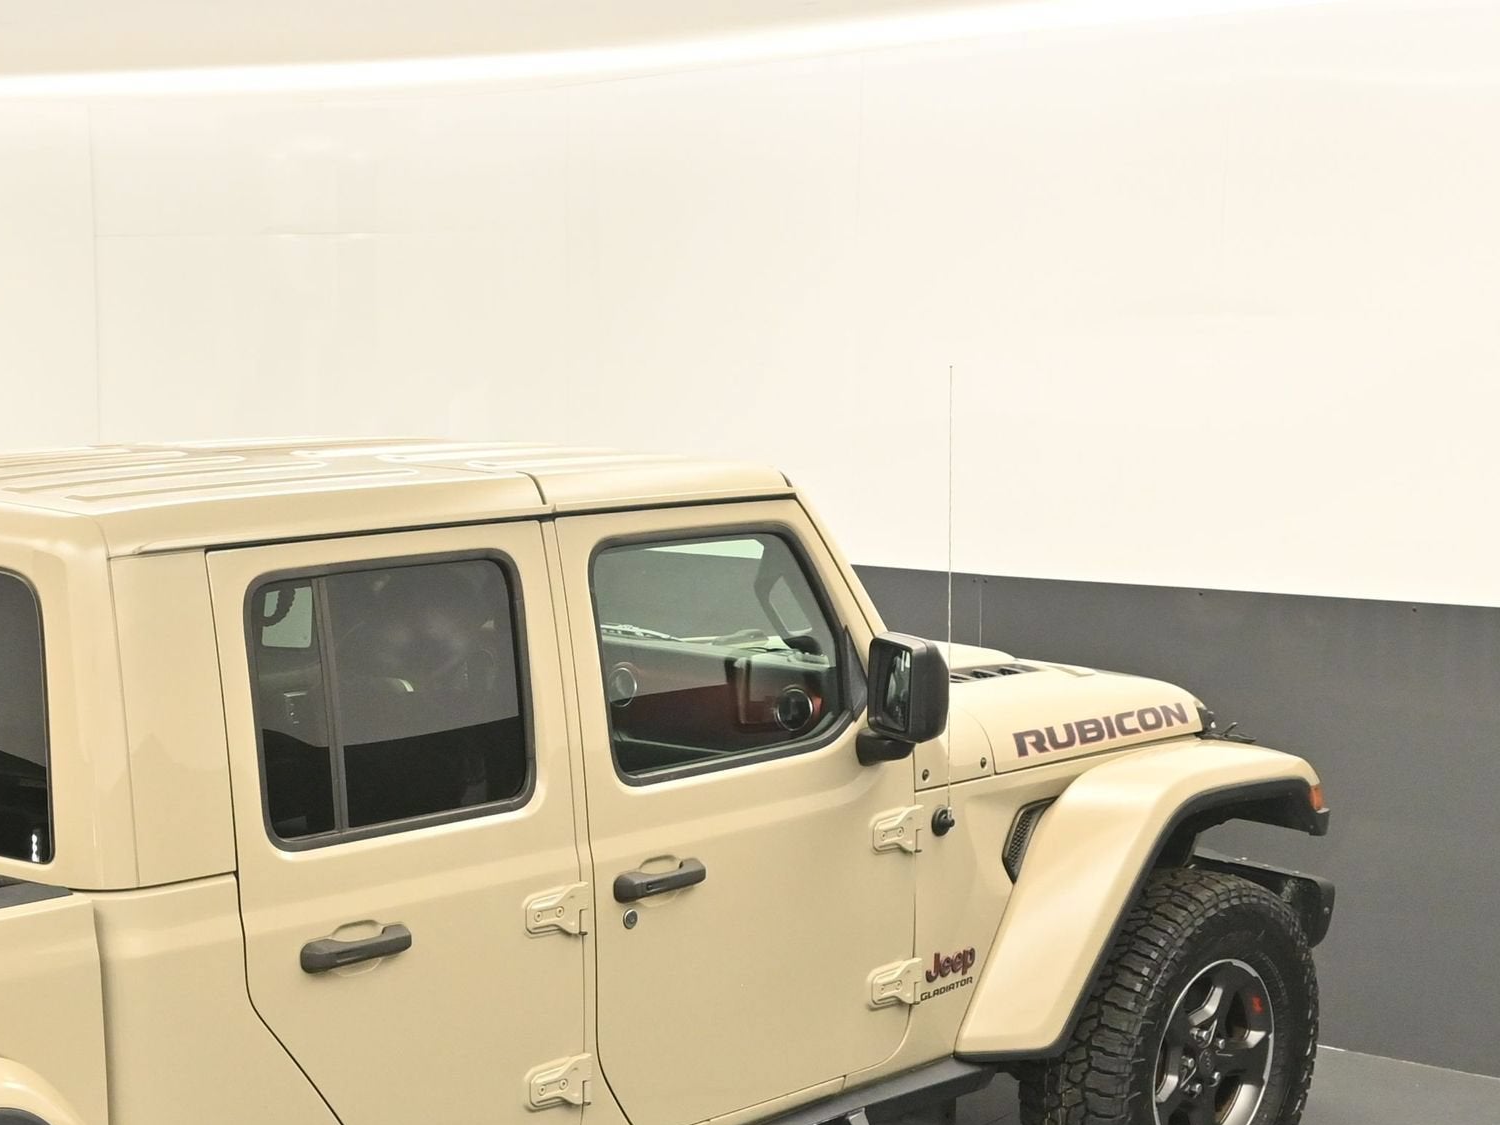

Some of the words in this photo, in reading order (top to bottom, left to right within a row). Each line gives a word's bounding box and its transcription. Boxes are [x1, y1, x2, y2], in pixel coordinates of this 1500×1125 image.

[1012, 703, 1189, 757] RUBICON
[925, 948, 975, 983] Jeep
[920, 976, 973, 1001] GLADIATOR
